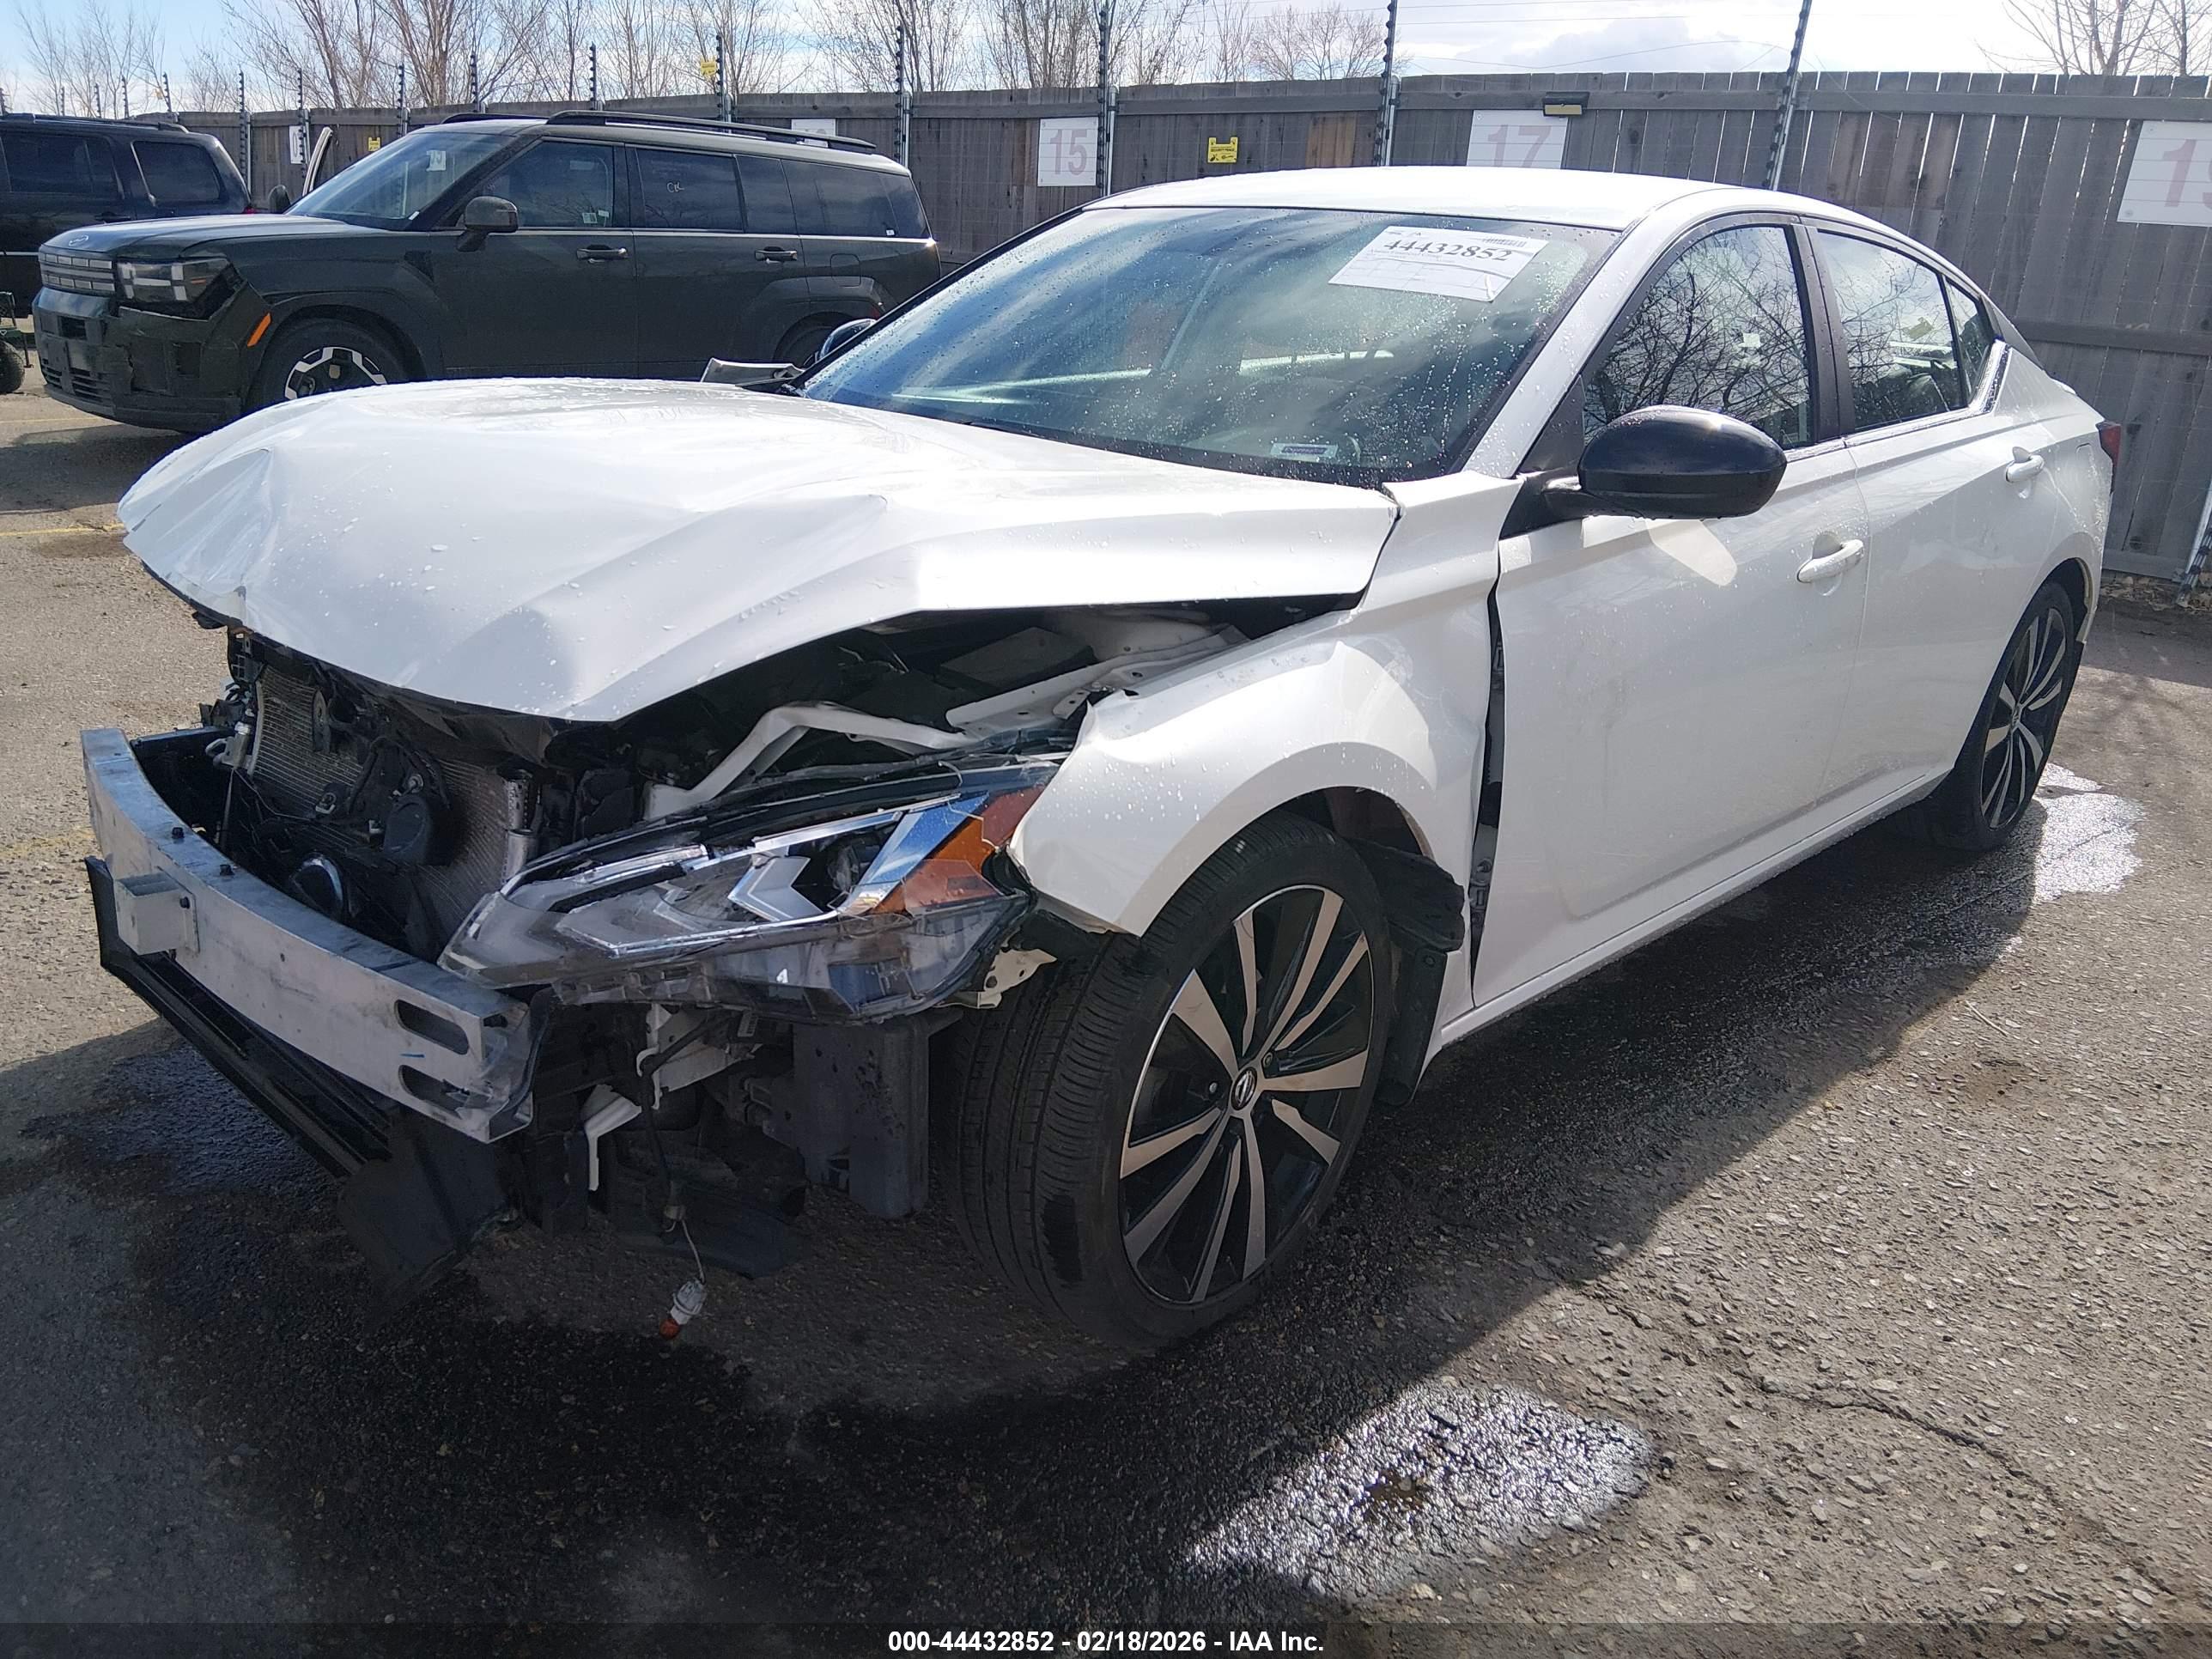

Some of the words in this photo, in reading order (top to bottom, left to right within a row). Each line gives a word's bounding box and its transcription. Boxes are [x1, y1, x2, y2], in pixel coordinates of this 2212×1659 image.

[1049, 129, 1087, 175] 15
[1487, 125, 1552, 167] 17
[1383, 240, 1512, 261] 44432852
